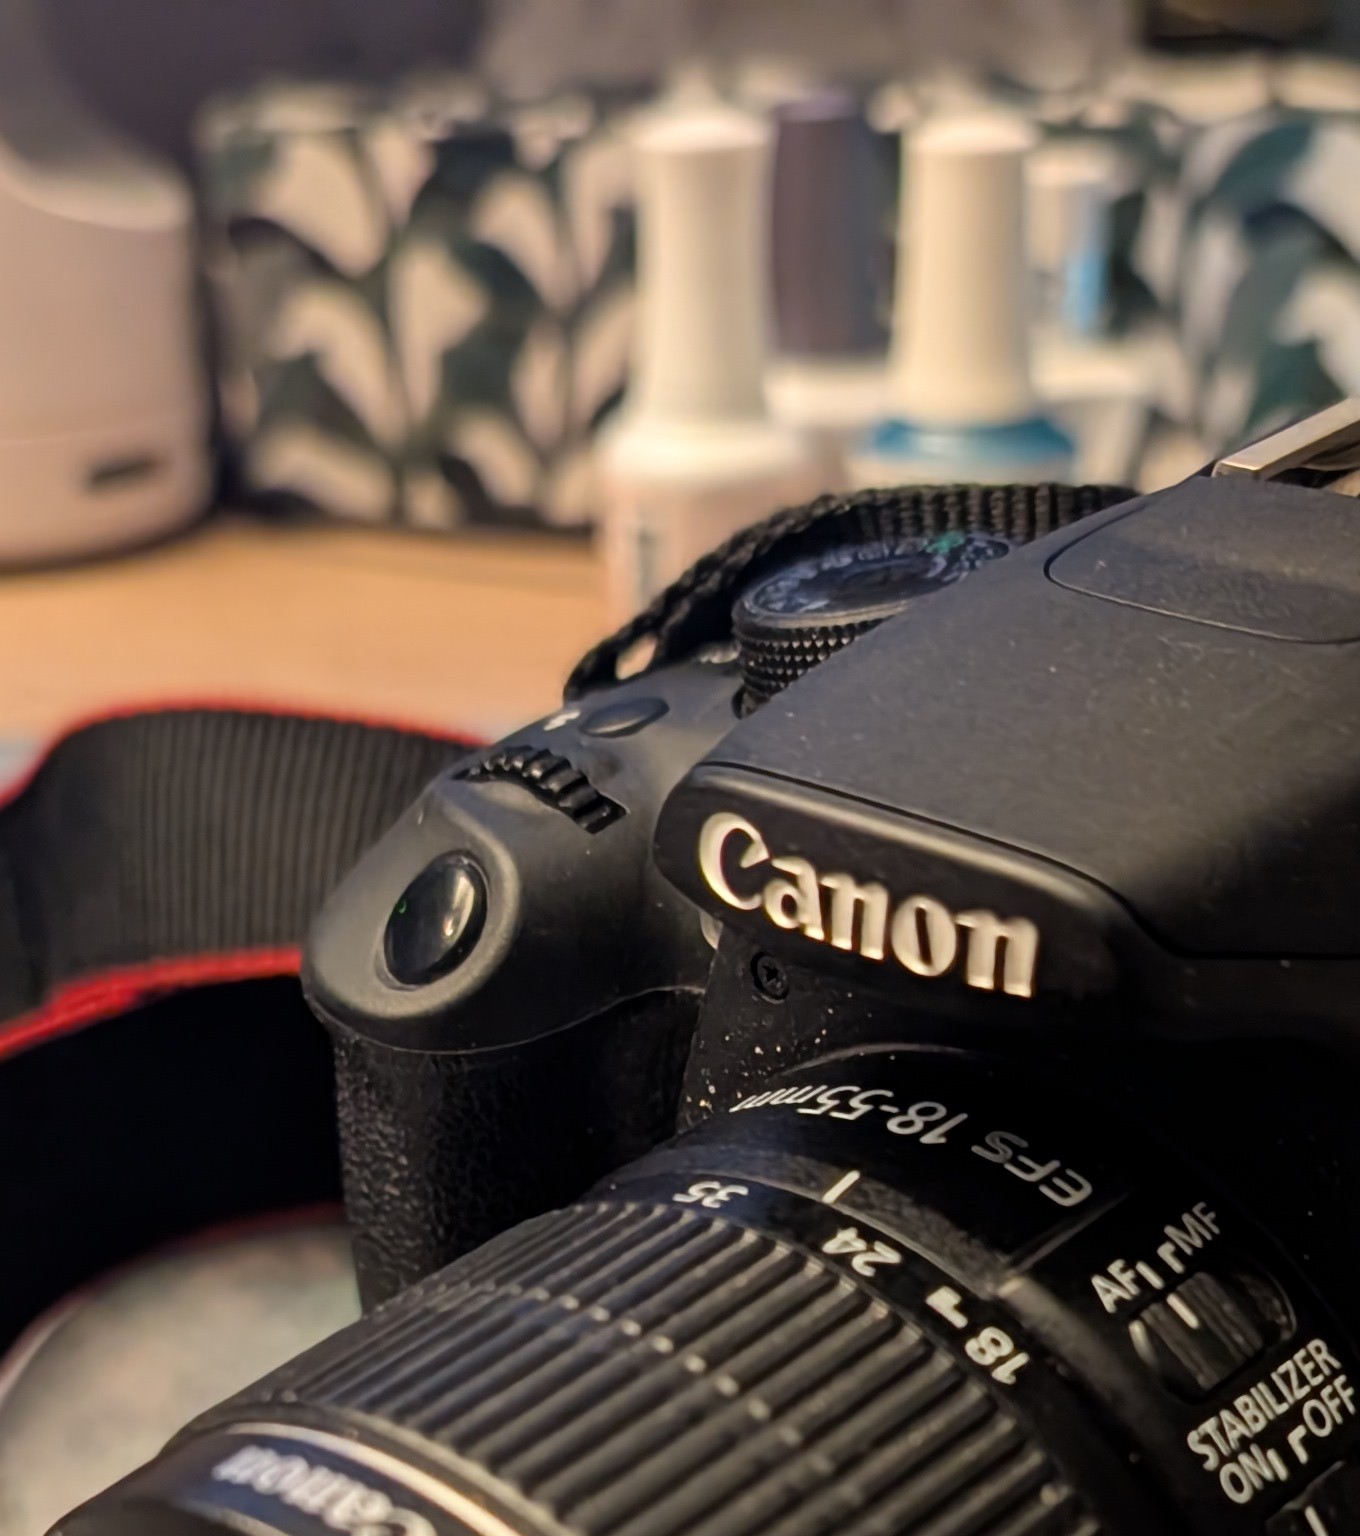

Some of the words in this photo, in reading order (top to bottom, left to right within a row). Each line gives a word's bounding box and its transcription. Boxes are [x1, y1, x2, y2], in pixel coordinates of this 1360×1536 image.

[698, 811, 1039, 999] Canon
[729, 1084, 968, 1145] 18-55mm
[673, 1180, 749, 1208] 35
[971, 1130, 1093, 1207] EFS
[822, 1226, 903, 1277] 24
[1092, 1259, 1140, 1313] AF
[1164, 1202, 1220, 1255] MF
[964, 1326, 1031, 1386] 18
[1187, 1338, 1341, 1471] STABILIZER
[1220, 1443, 1275, 1503] ON
[1303, 1374, 1356, 1437] OFF
